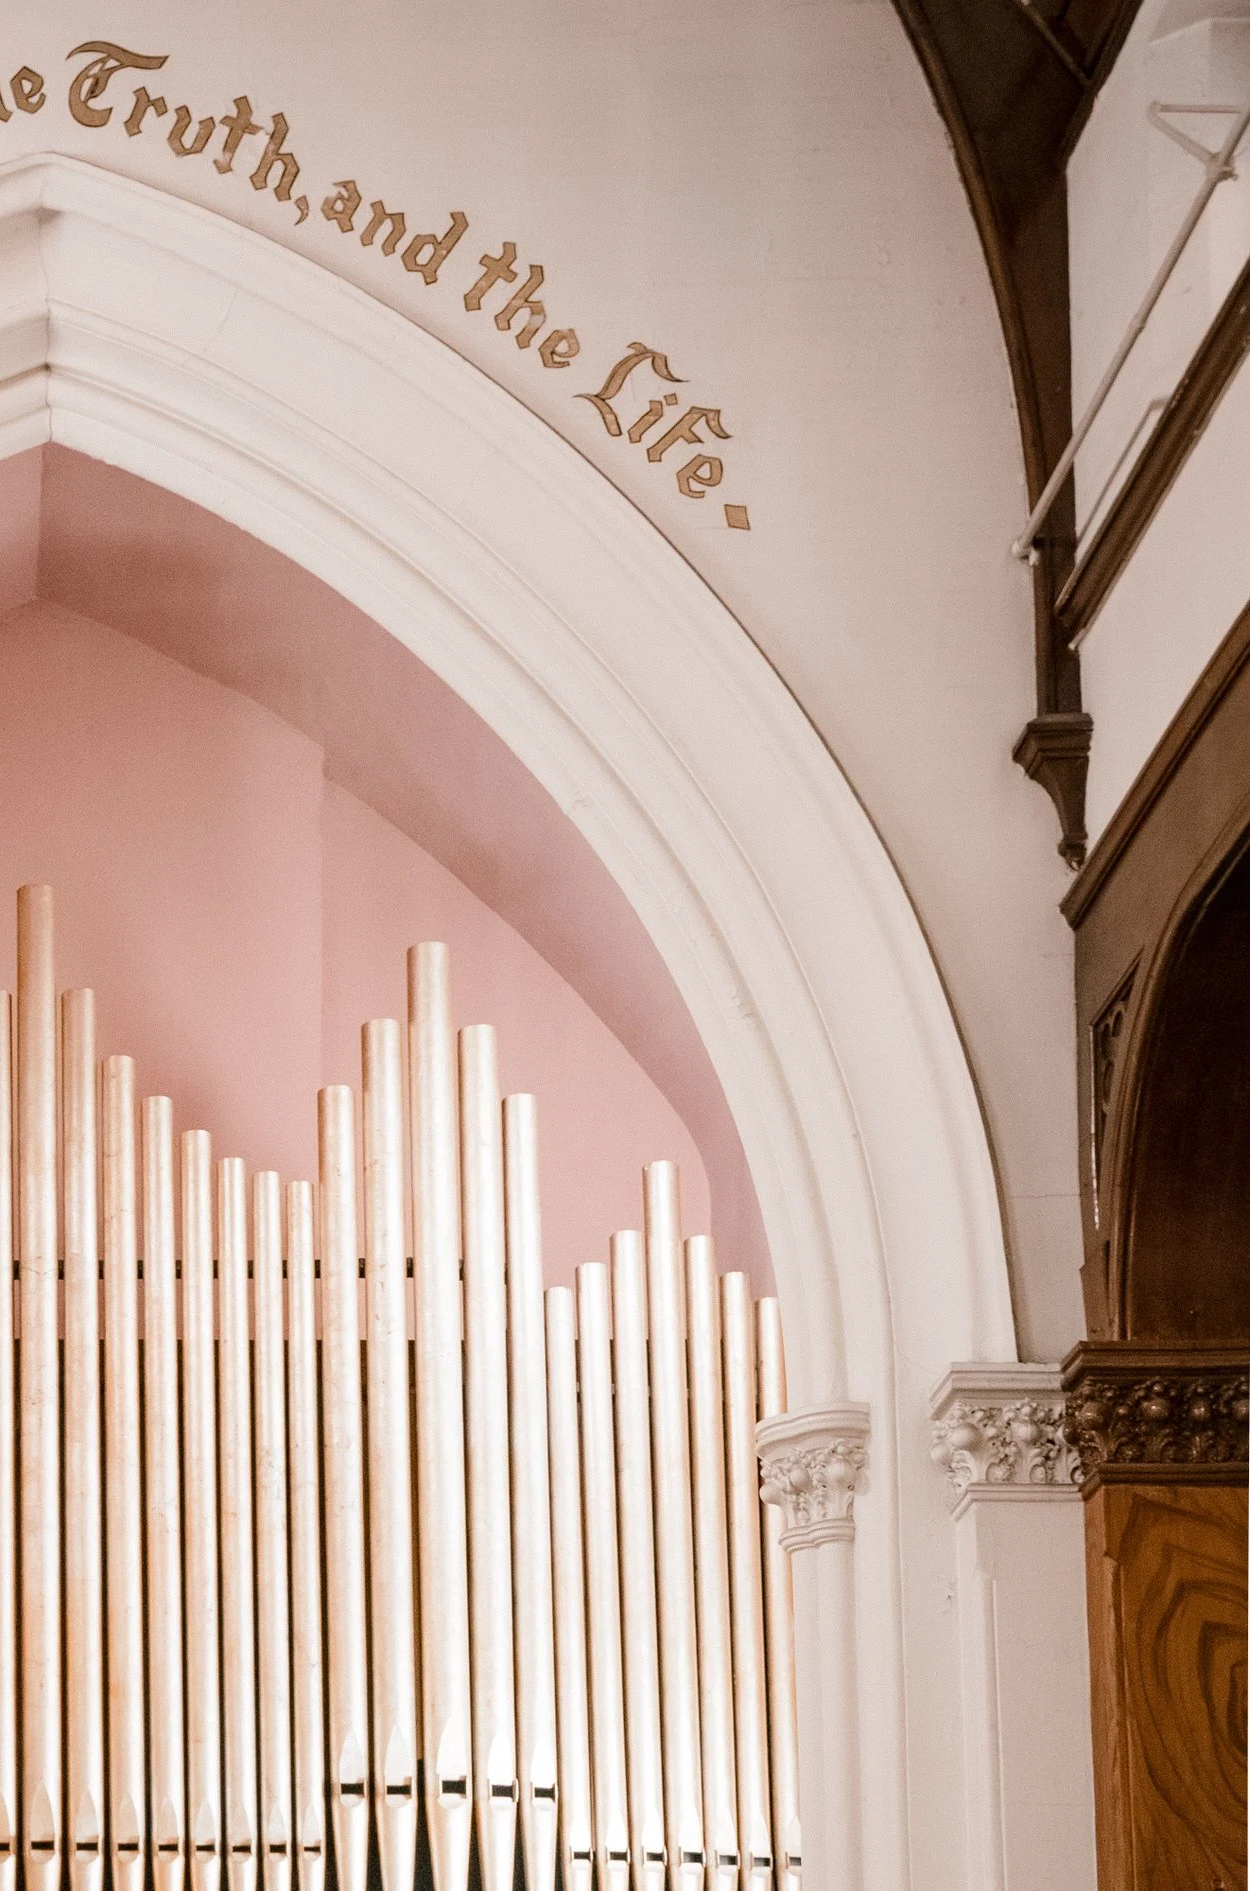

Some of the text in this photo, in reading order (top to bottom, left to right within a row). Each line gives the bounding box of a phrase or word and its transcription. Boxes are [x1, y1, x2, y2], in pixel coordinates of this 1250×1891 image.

[65, 40, 309, 226] Truth,
[320, 179, 469, 286] and
[462, 242, 581, 369] the
